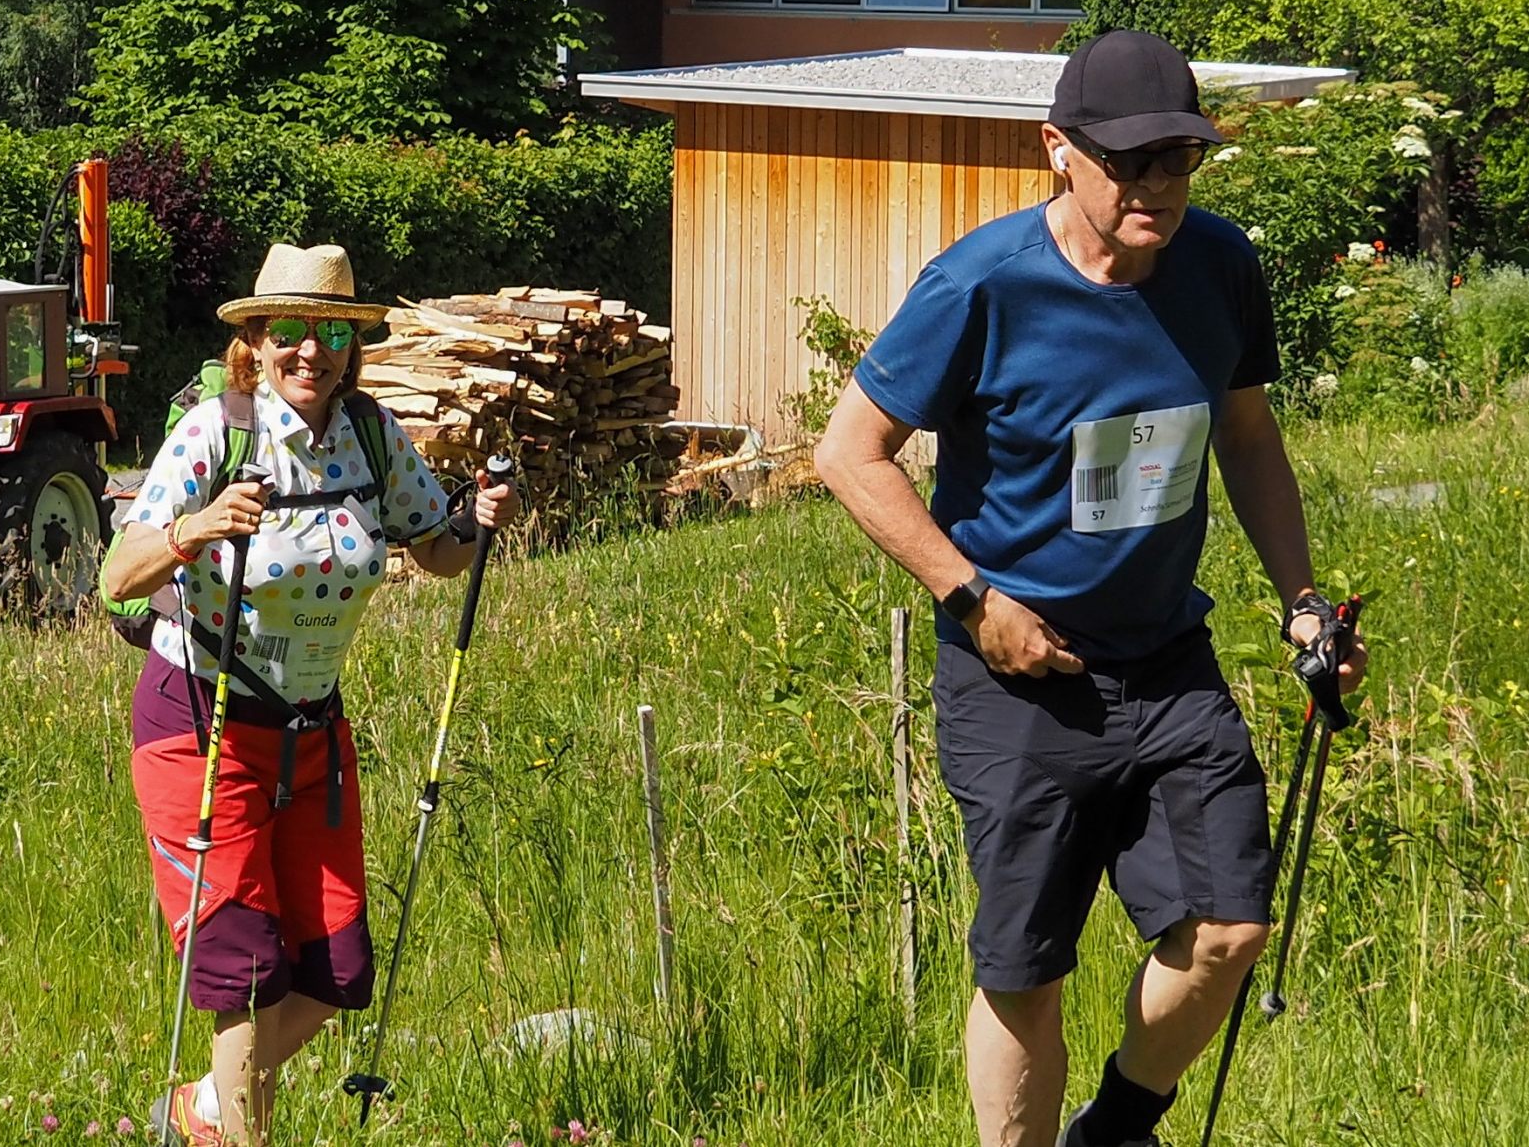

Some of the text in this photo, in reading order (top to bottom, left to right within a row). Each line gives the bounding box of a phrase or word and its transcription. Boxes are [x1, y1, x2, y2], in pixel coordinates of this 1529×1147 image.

[1132, 425, 1155, 444] 57
[1092, 510, 1105, 521] 57
[294, 613, 337, 627] Gunda
[259, 664, 271, 674] 23
